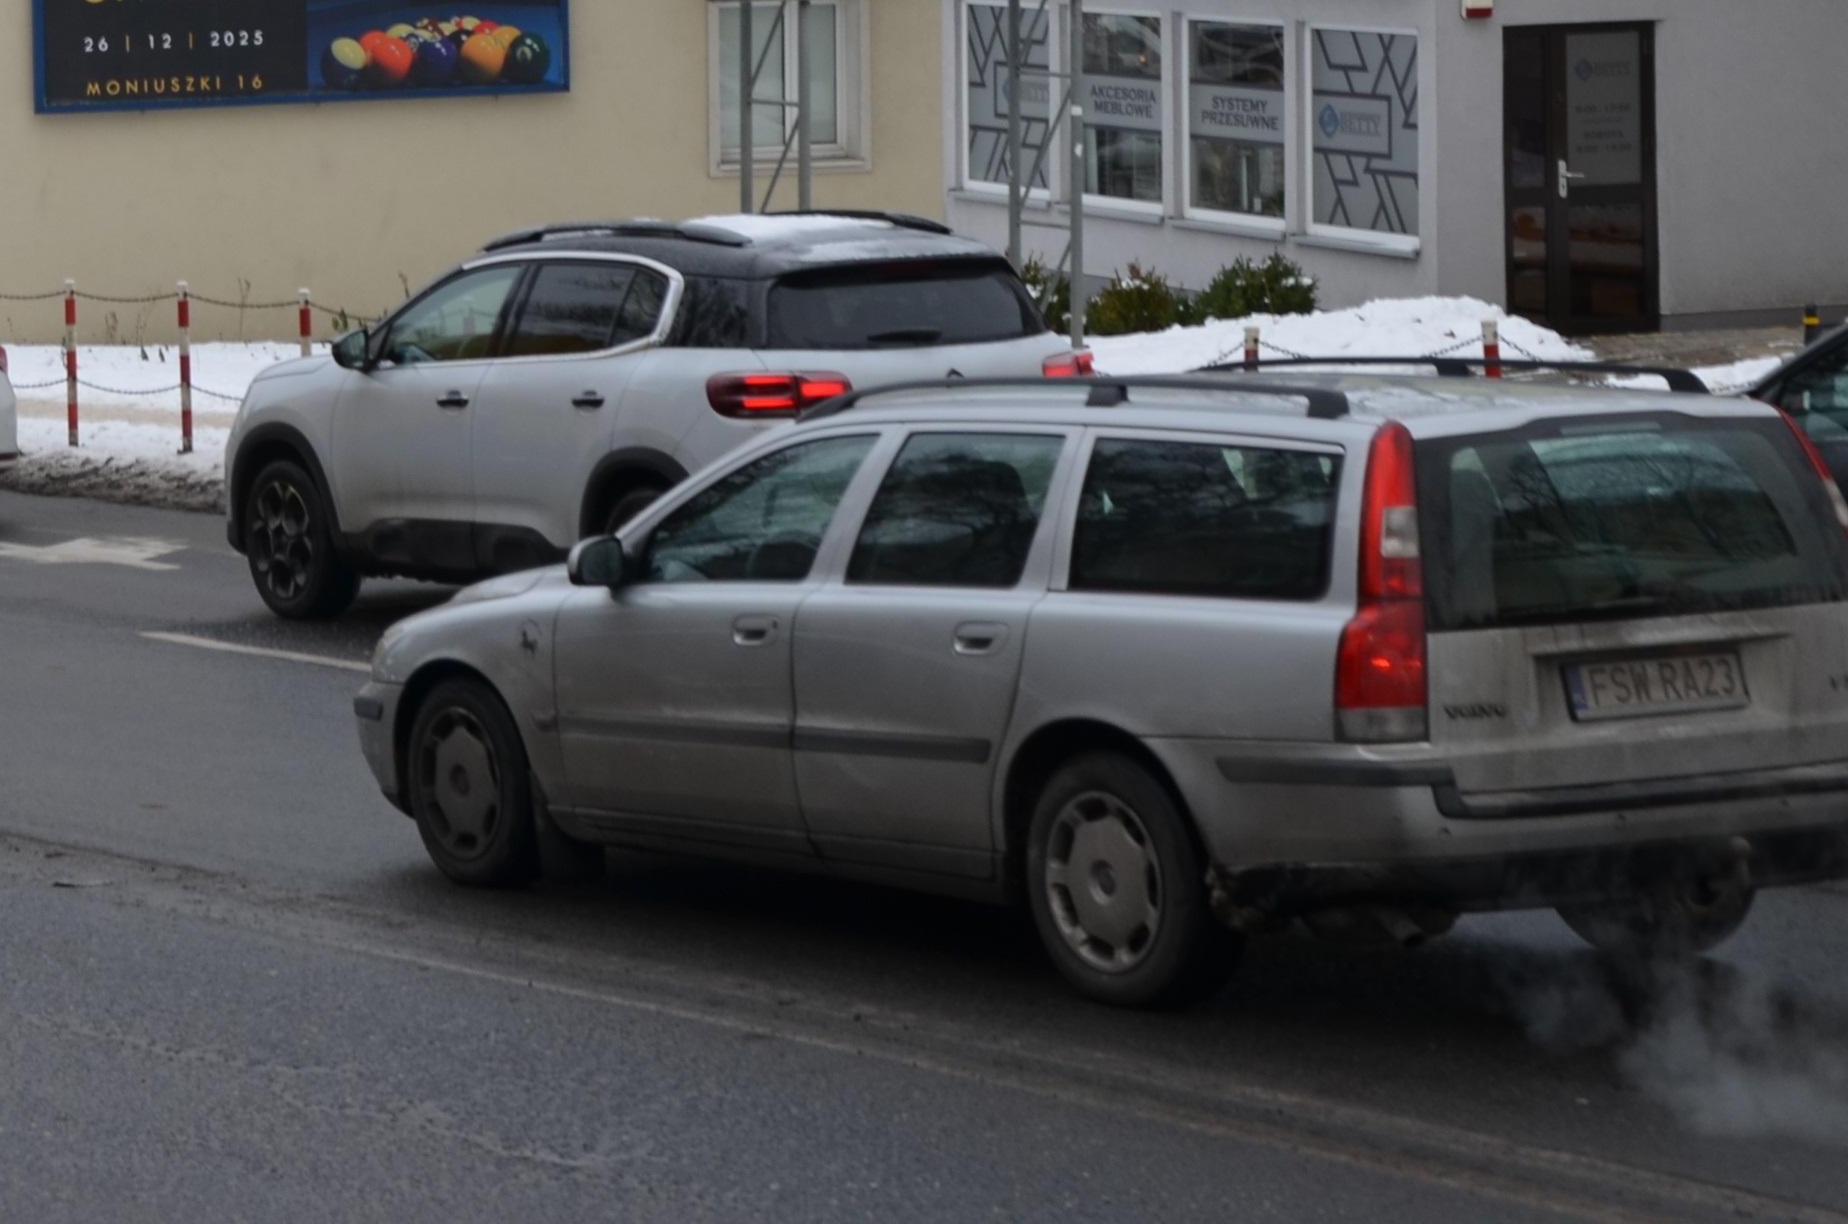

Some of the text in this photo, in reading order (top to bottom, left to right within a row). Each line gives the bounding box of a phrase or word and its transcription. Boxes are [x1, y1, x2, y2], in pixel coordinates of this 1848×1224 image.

[84, 36, 109, 53] 26
[148, 33, 172, 50] 12
[210, 29, 264, 47] 2025
[86, 74, 263, 96] MONIUSZKI 16
[1090, 84, 1156, 103] AKCESORIA
[1094, 99, 1152, 119] MEBLOWE
[1212, 95, 1268, 114] SYSTEMY
[1202, 109, 1279, 131] PRZESUWNE
[1587, 657, 1736, 708] FSW RA23
